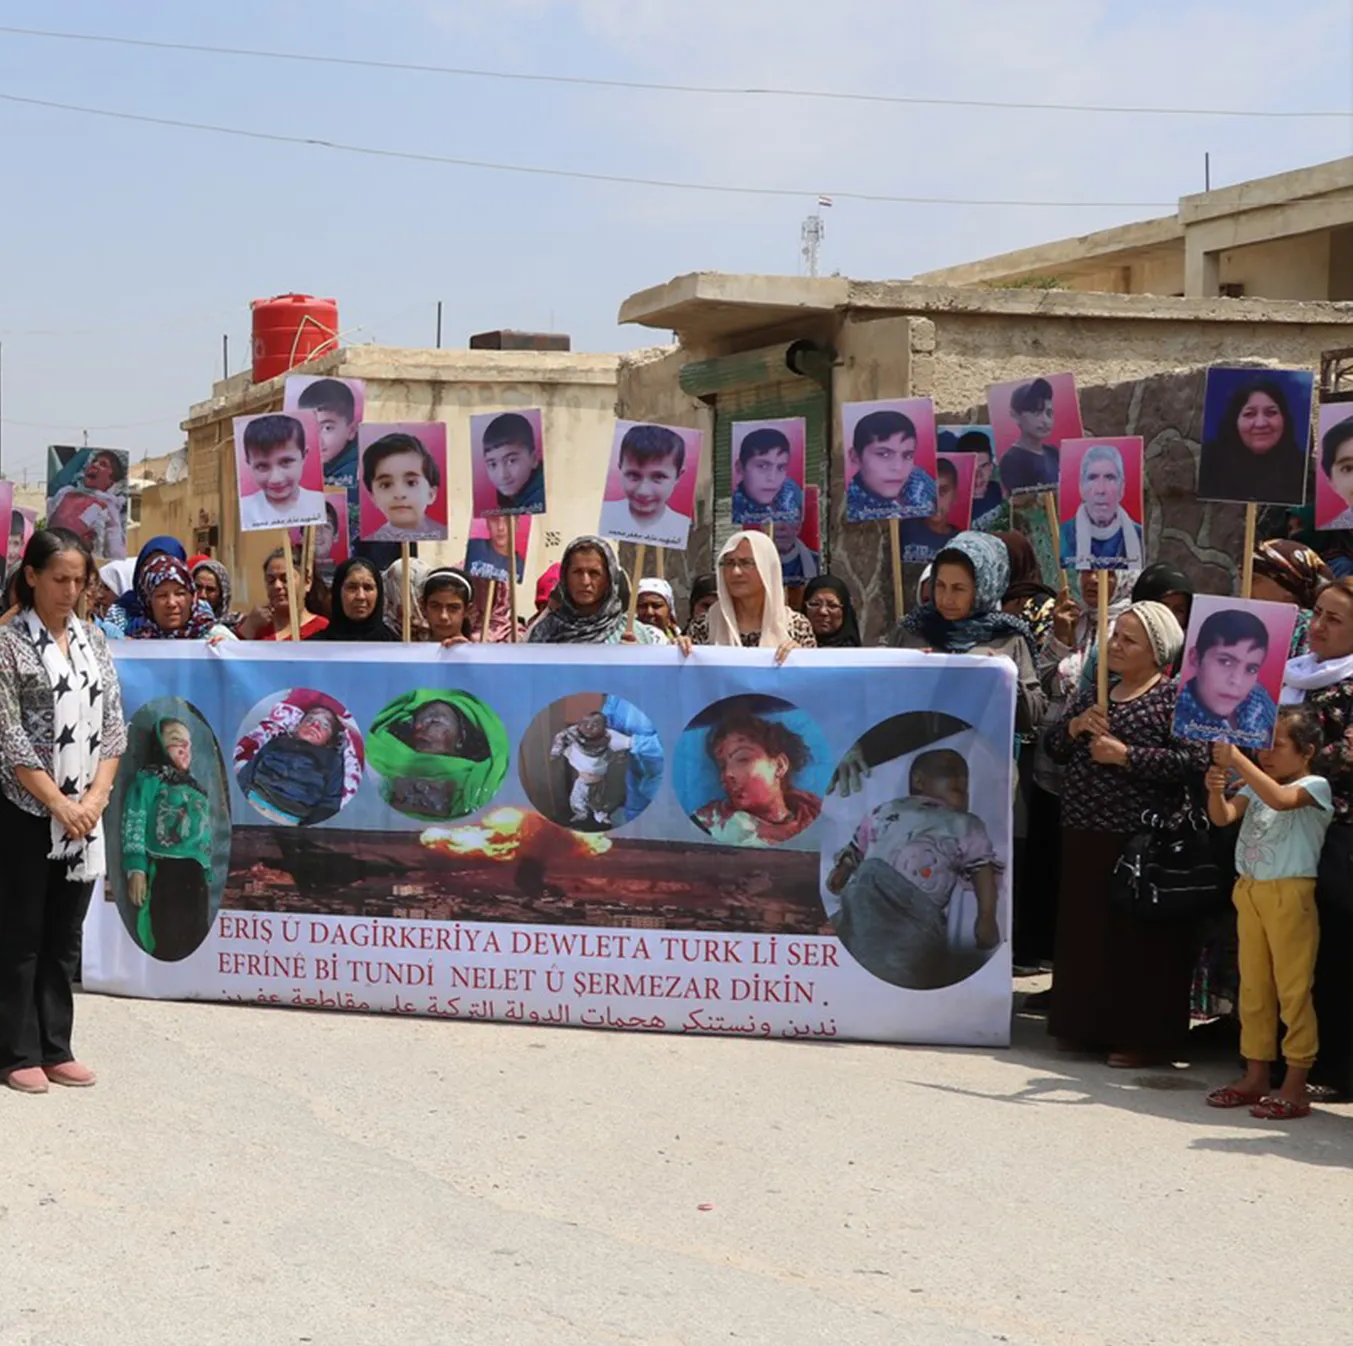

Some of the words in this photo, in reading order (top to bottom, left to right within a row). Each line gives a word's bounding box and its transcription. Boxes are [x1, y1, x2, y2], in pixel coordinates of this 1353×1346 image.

[309, 919, 501, 953] DAGİRKERİYA
[511, 931, 651, 960] DEWLETA
[661, 936, 743, 963] TURK
[752, 936, 777, 966] Lİ
[787, 943, 840, 967] SER
[315, 952, 339, 980] Bİ
[451, 966, 536, 991] NELET
[573, 971, 722, 1000] ŞERMEZAR
[731, 973, 815, 1004] DİKİN
[291, 988, 370, 1009] مقاطعة
[505, 1000, 569, 1025] الدولة
[681, 1008, 771, 1036] ونستنكر
